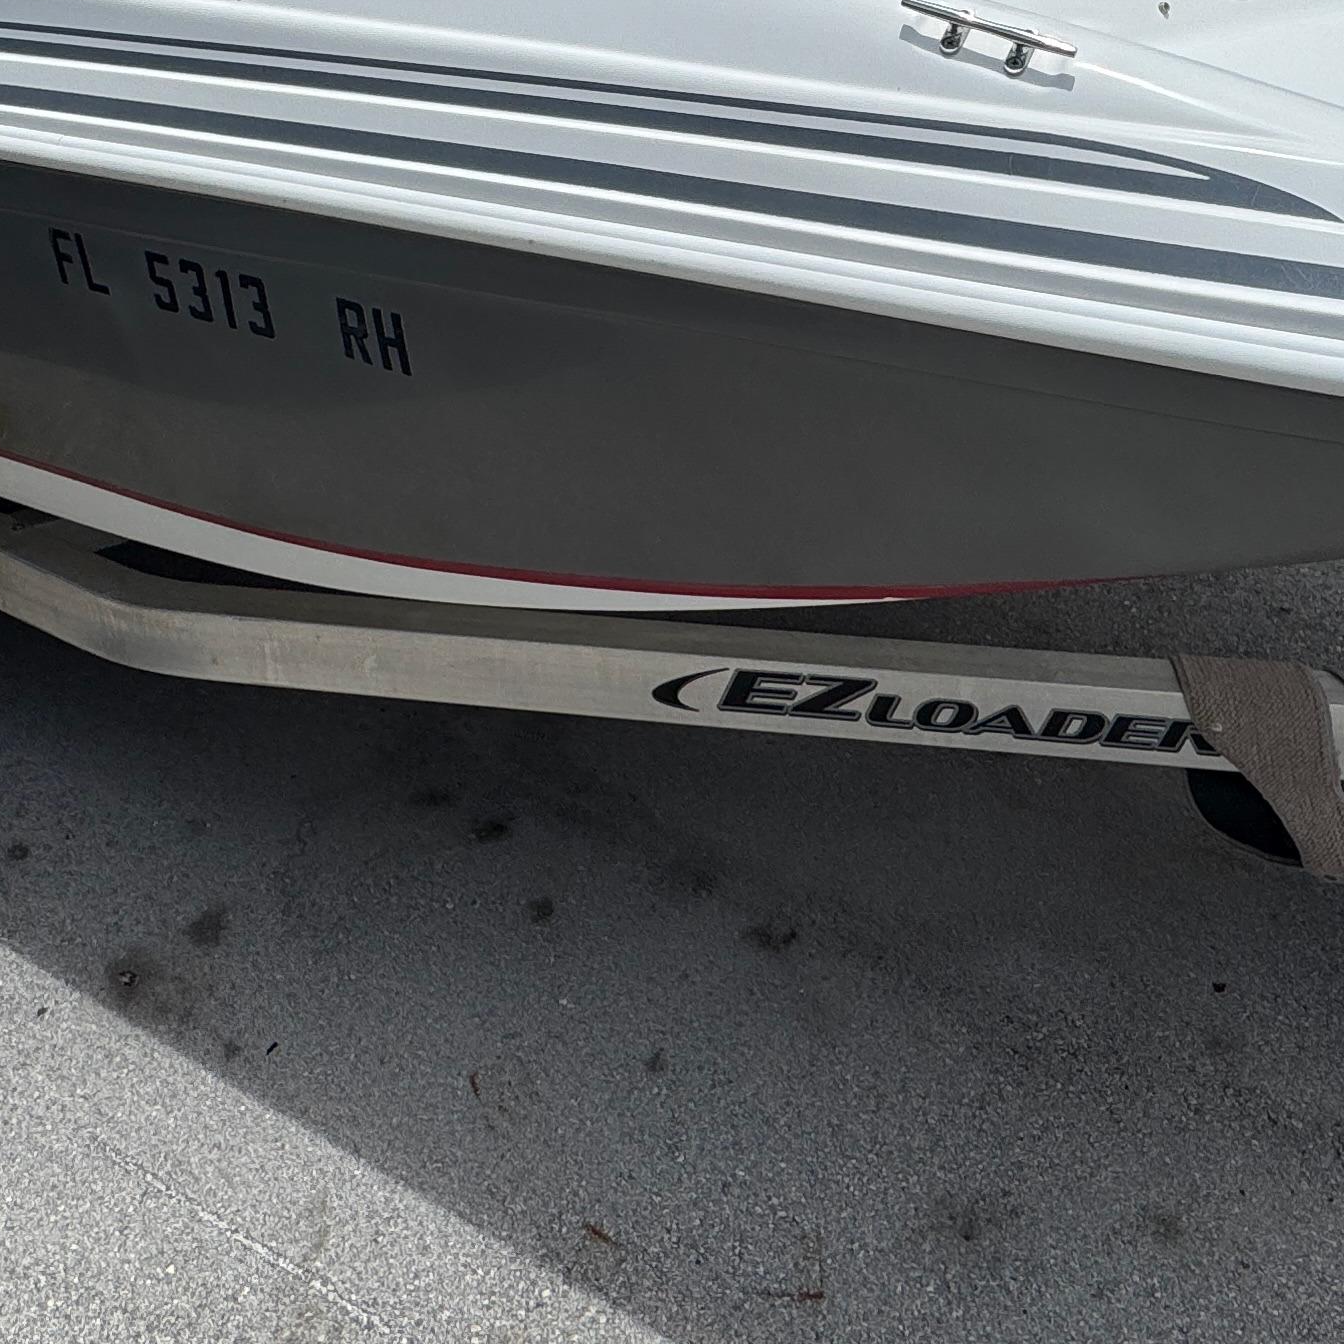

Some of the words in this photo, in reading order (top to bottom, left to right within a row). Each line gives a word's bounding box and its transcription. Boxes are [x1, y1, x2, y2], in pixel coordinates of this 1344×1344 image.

[48, 227, 111, 296] FL
[144, 250, 277, 340] 5313
[335, 296, 413, 377] RH
